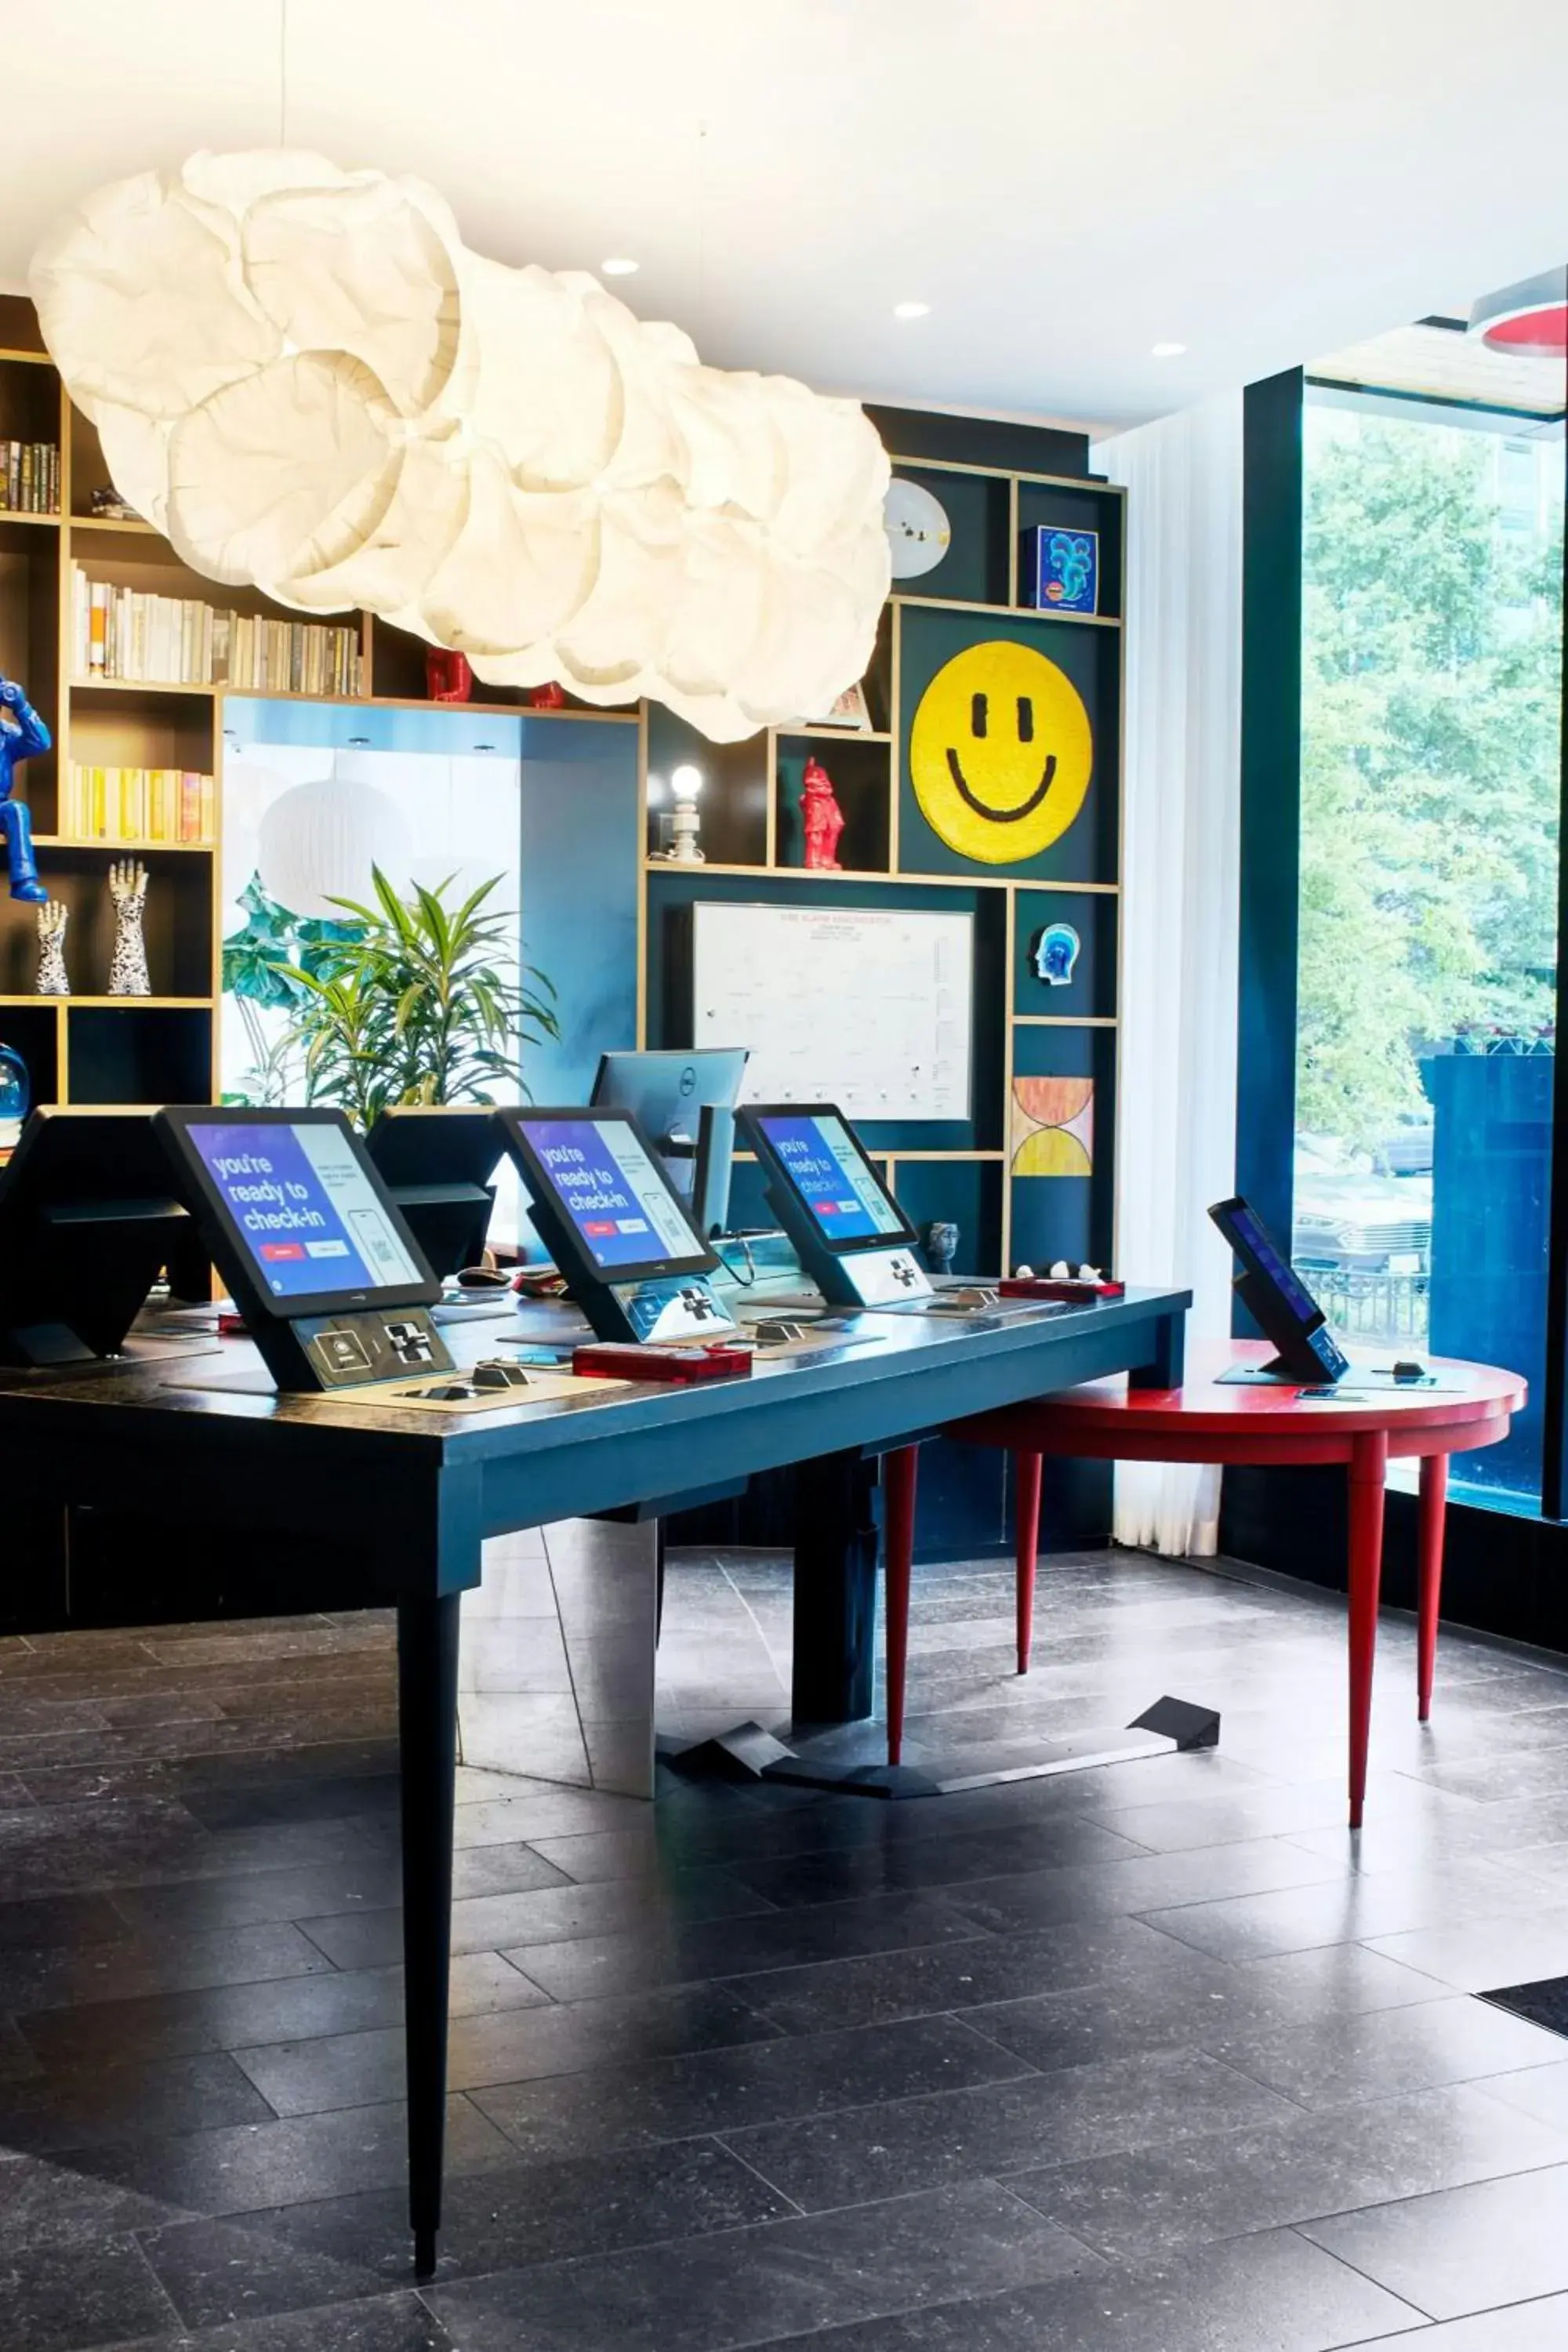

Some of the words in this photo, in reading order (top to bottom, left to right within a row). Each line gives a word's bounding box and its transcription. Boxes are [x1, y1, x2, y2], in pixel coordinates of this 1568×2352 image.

[212, 1153, 273, 1180] you're
[540, 1145, 585, 1167] you're
[555, 1167, 597, 1189] ready
[593, 1168, 613, 1185] to
[228, 1179, 285, 1206] ready
[285, 1181, 308, 1200] to
[569, 1191, 628, 1210] check-in
[244, 1207, 326, 1230] check-in
